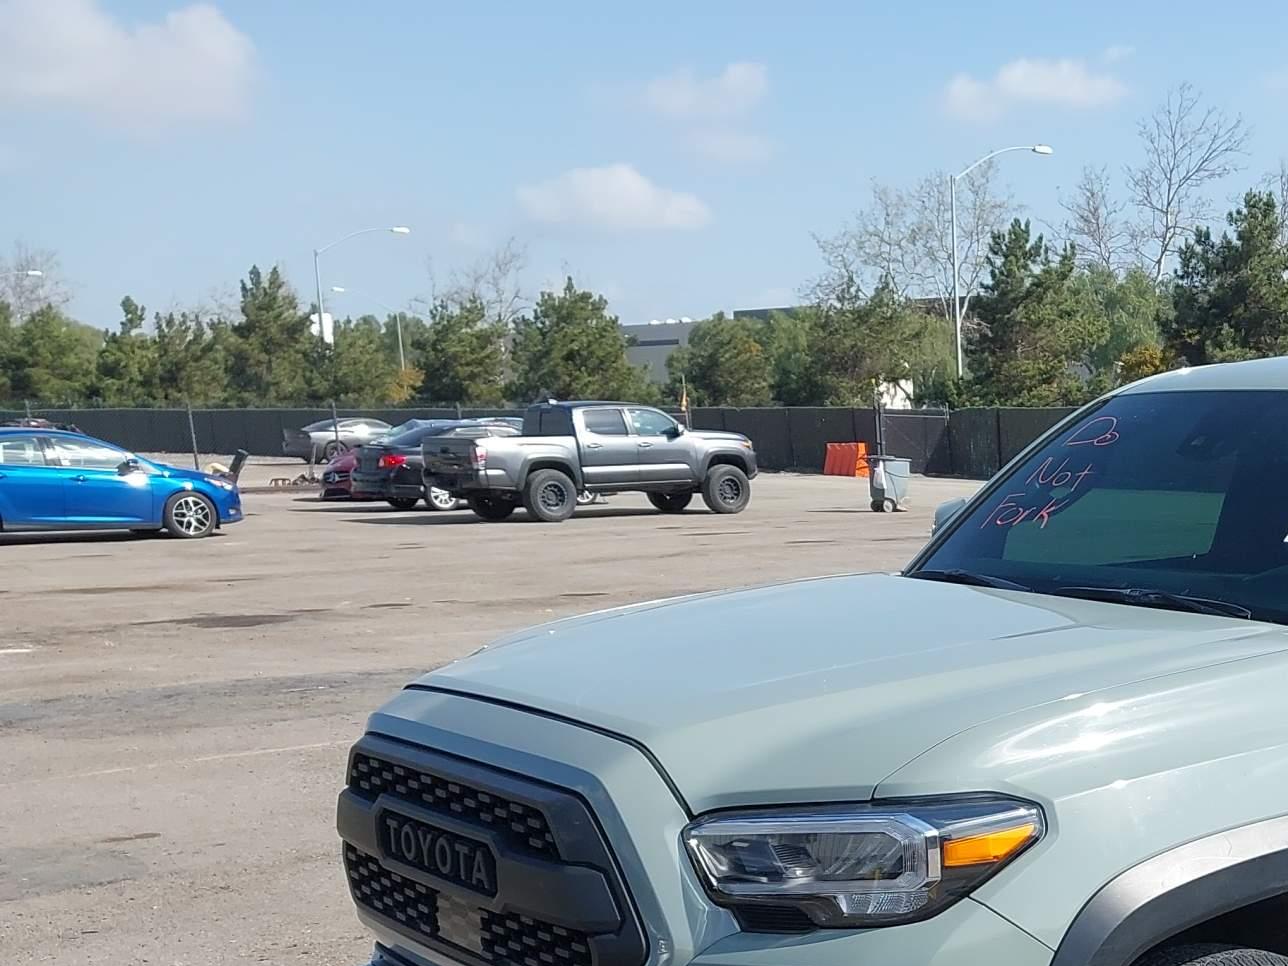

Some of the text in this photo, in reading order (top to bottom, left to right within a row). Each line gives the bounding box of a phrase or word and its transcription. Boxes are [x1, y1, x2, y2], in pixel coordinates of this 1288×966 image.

[1062, 416, 1120, 446] Do
[1025, 456, 1095, 492] Not
[980, 493, 1070, 529] Fork
[386, 818, 490, 889] TOYOTA
